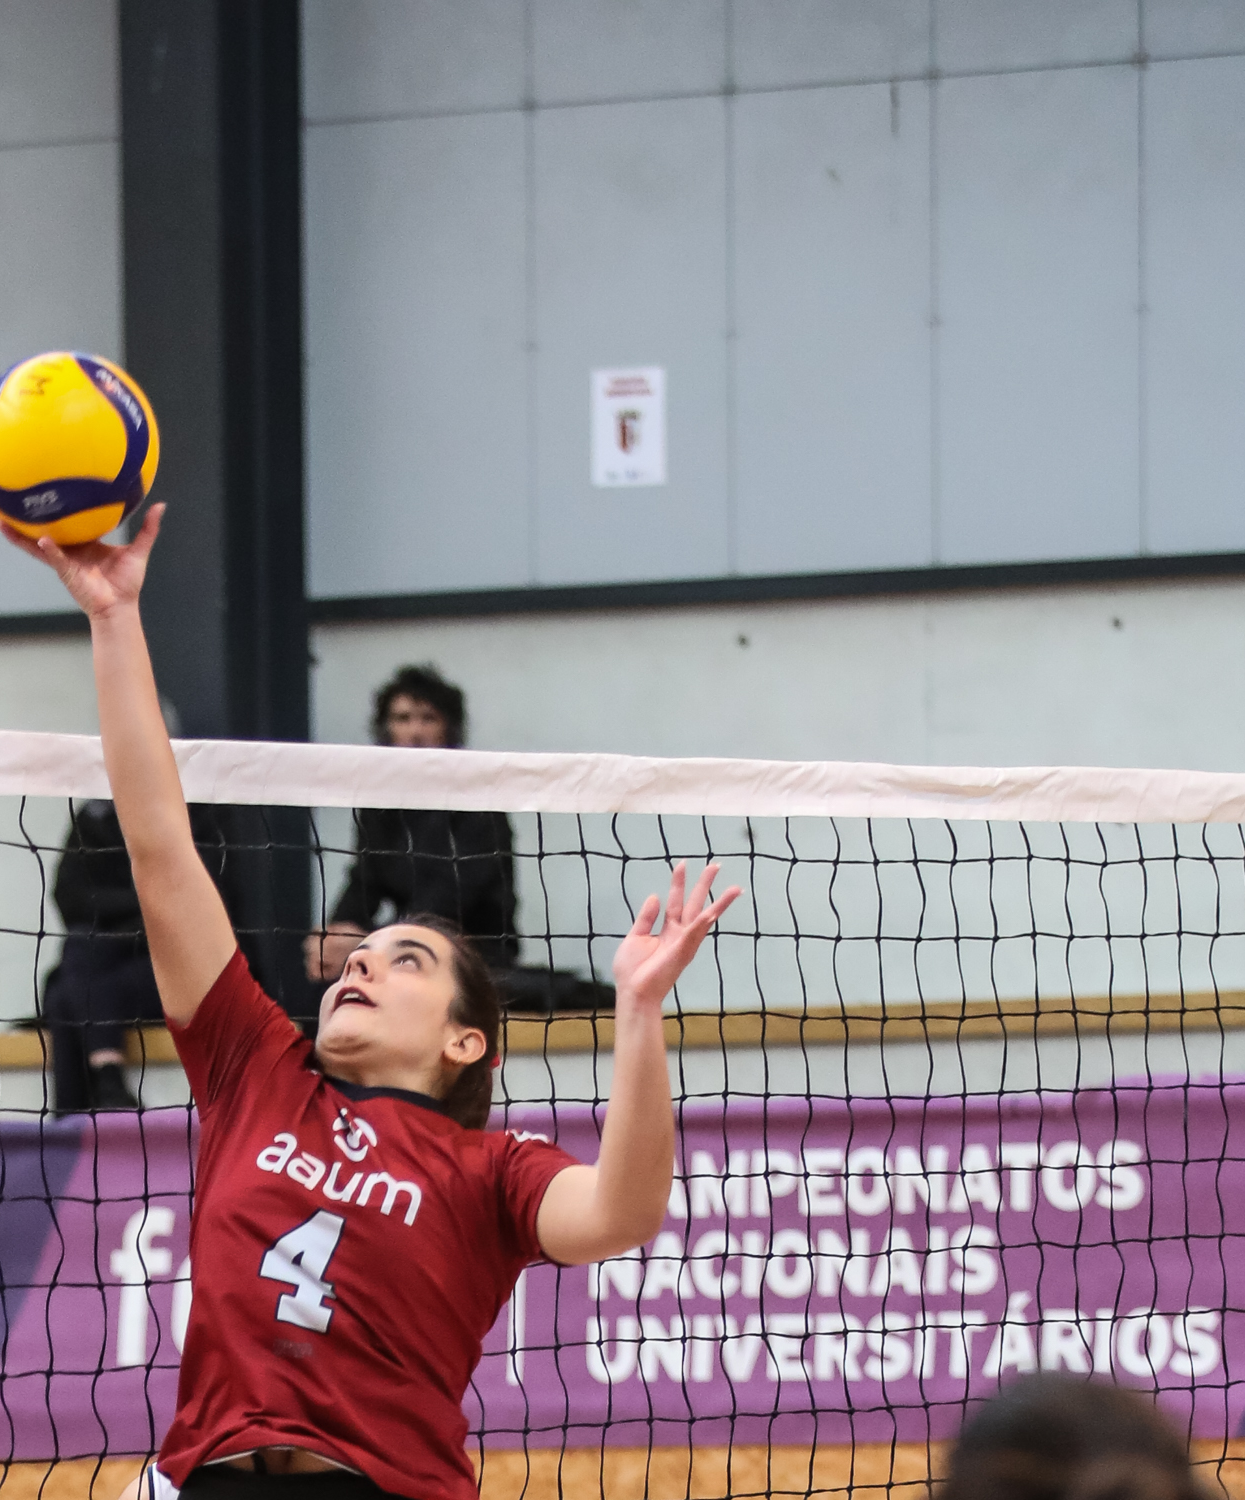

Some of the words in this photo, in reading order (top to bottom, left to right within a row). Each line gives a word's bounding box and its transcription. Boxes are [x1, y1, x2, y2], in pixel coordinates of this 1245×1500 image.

[256, 1131, 423, 1227] aaum
[258, 1207, 346, 1335] 4
[587, 1226, 1000, 1300] NACIONAIS
[585, 1292, 1222, 1384] UNIVERSITÁRIOS
